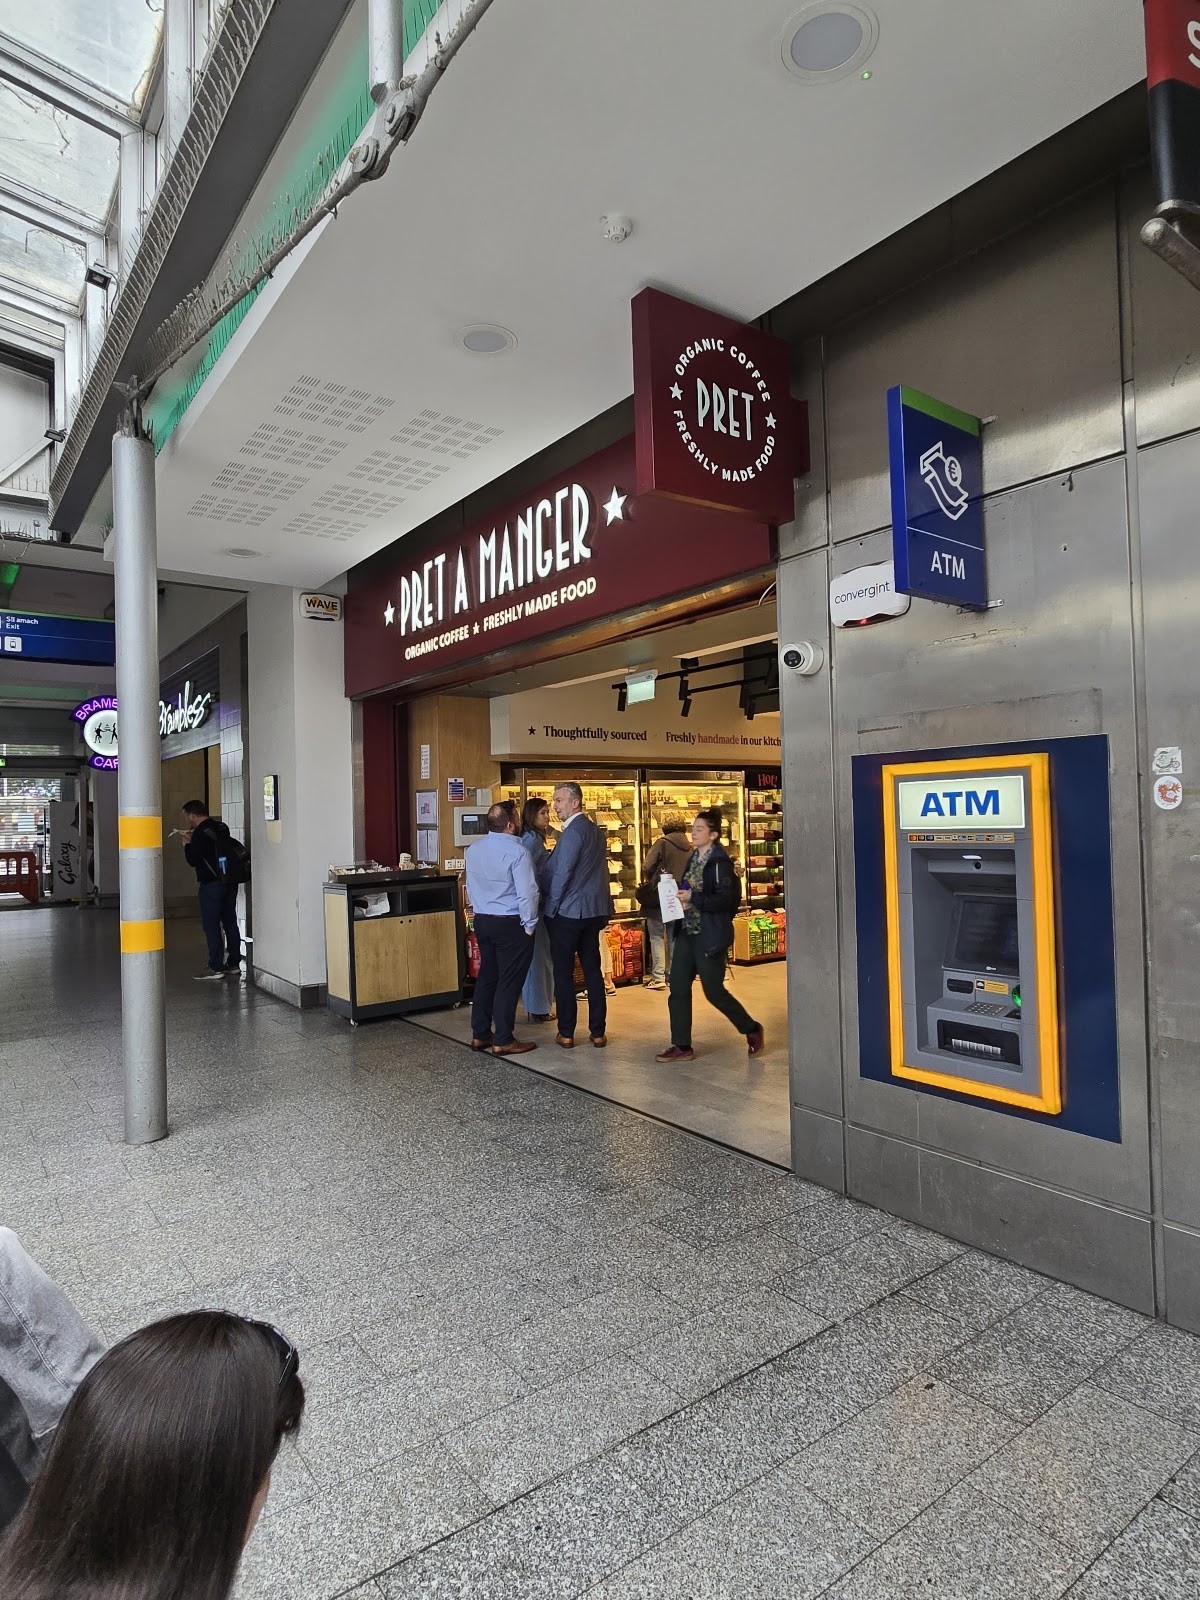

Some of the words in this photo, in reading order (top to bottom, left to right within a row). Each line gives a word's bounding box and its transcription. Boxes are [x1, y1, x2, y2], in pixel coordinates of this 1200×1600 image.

[675, 338, 724, 376] ORGANIC
[730, 346, 770, 402] COFFEE
[696, 377, 754, 441] PRET
[674, 410, 718, 474] FRESHLY
[722, 466, 756, 482] MADE
[755, 436, 775, 472] FOOD
[400, 552, 446, 636] PRET
[454, 545, 469, 614] A
[479, 484, 592, 604] MANGER
[930, 550, 966, 580] ATM
[306, 598, 338, 610] WAVE
[834, 580, 890, 605] convergint
[404, 636, 438, 660] ORGANIC
[438, 624, 470, 648] COFFEE
[483, 603, 523, 632] FRESHLY
[524, 590, 558, 618] MADE
[560, 576, 597, 604] FOOD
[542, 725, 609, 742] Thoughtfully
[610, 730, 648, 741] sourced
[666, 731, 696, 746] Freshly
[698, 732, 740, 745] handmade
[740, 735, 749, 745] in
[749, 738, 763, 746] our
[763, 736, 782, 747] kitch
[920, 788, 1000, 817] ATM
[57, 840, 78, 884] Galaxy
